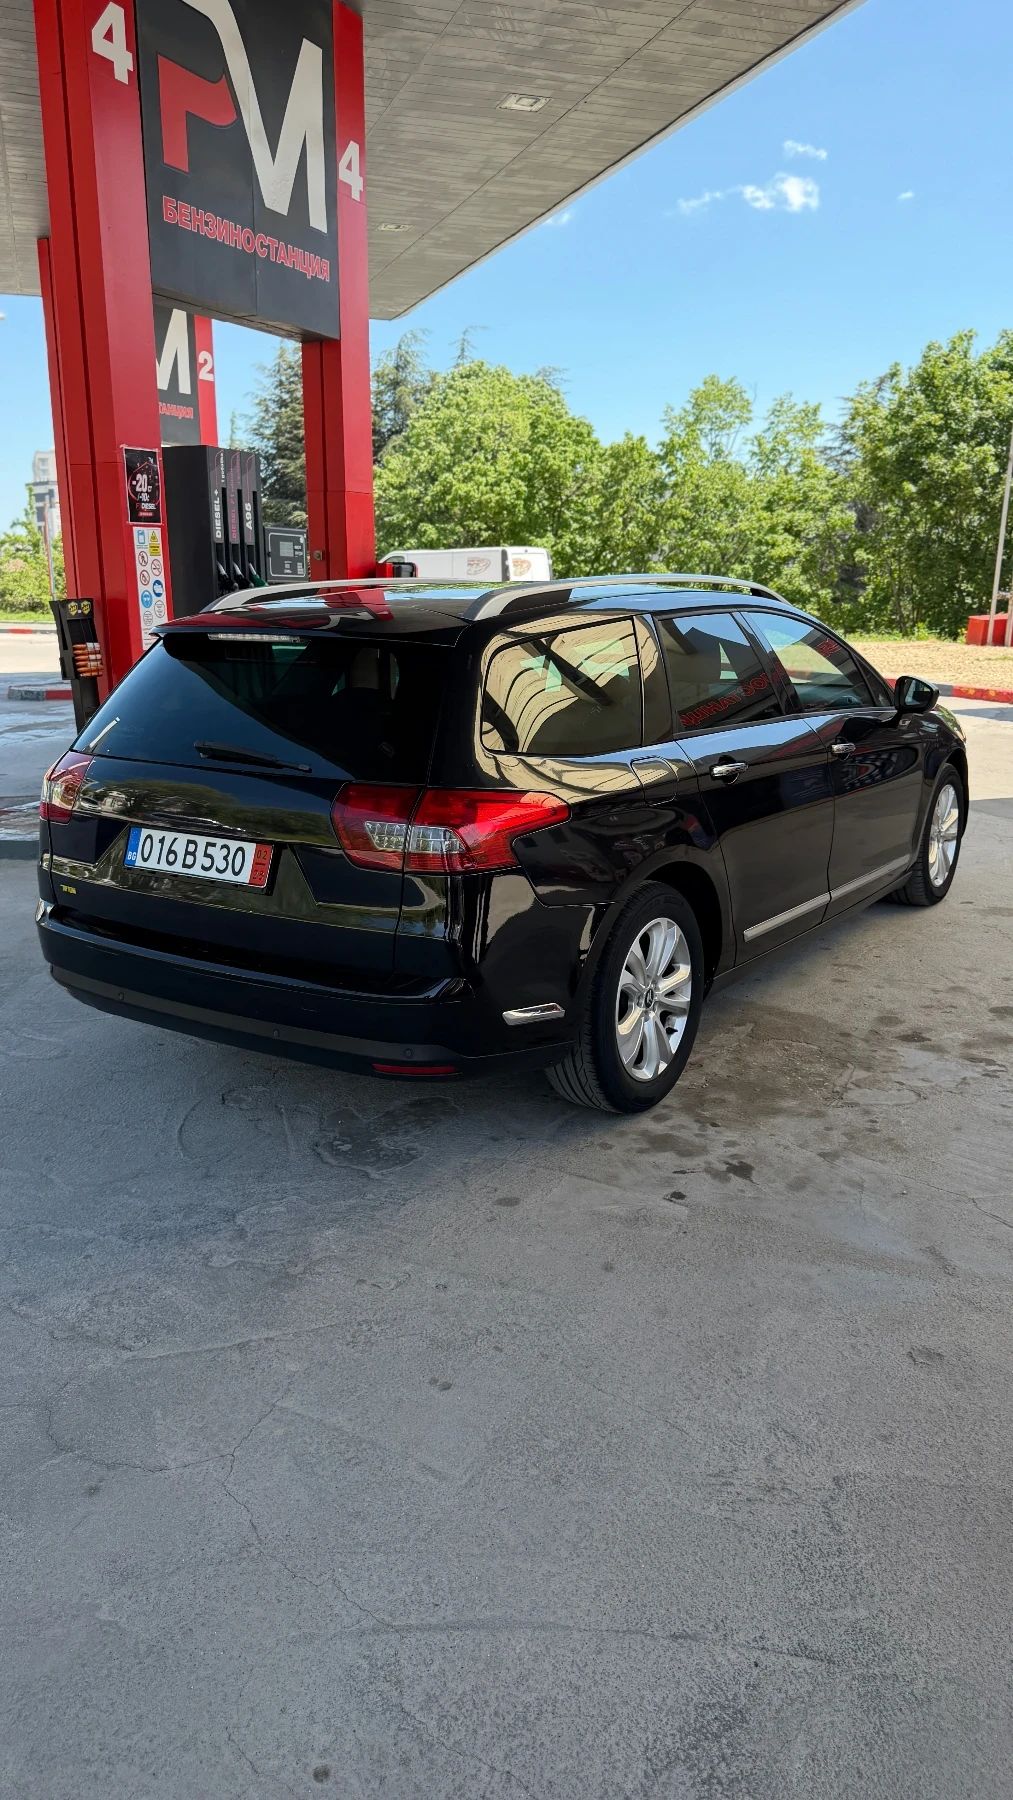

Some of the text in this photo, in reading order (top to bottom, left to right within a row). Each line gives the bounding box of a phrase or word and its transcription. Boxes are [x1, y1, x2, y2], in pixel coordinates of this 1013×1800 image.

[92, 2, 133, 85] 4
[338, 140, 364, 202] 4
[162, 195, 330, 282] БЕНЗИНОСТАНЦИЯ
[198, 350, 215, 382] 2
[132, 473, 148, 493] -20
[213, 497, 222, 539] DIESEL
[127, 851, 137, 861] BG
[256, 849, 268, 861] 02
